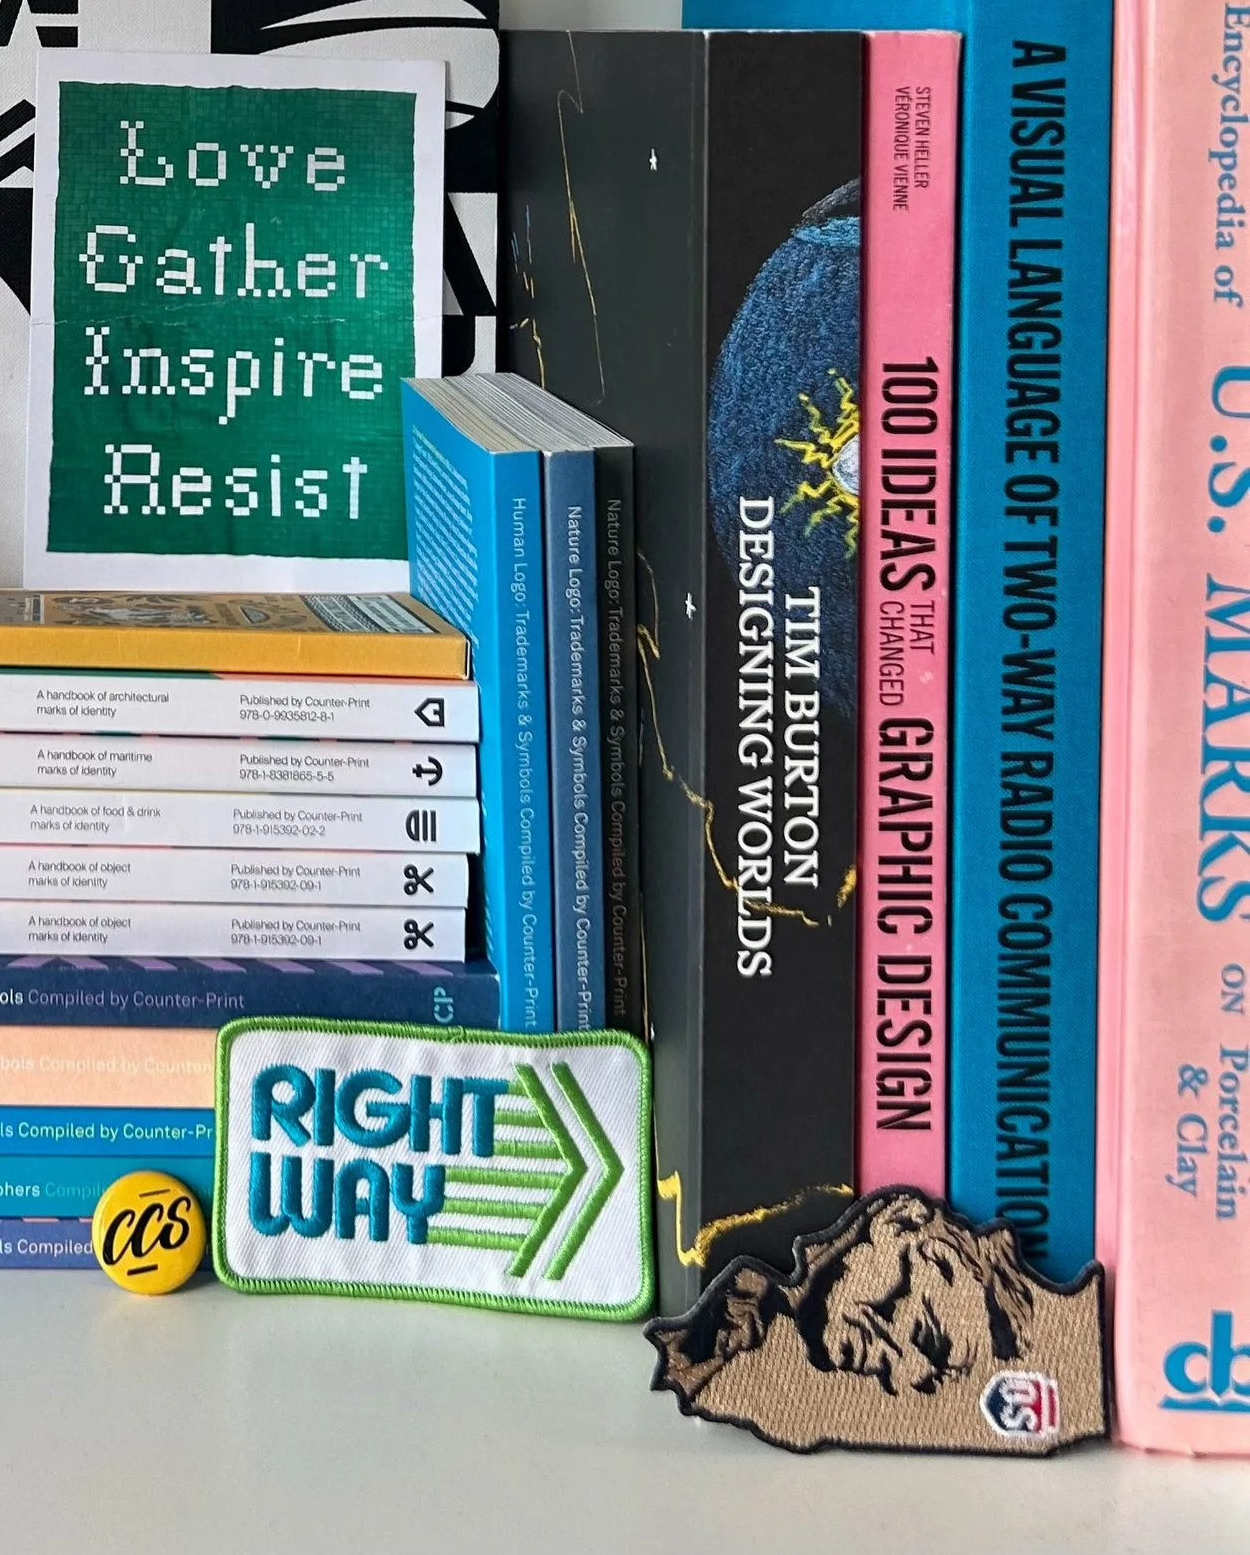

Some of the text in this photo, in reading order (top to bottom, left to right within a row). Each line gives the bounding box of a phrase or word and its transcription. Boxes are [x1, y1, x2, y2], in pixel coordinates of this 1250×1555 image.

[1011, 40, 1067, 68] A
[120, 120, 345, 191] Love
[892, 86, 913, 212] VÉRONIQUE VIENNE
[912, 86, 931, 189] STEVEN HELLER
[1009, 79, 1066, 228] VISUAL
[1207, 2, 1249, 308] Encyclopedia of
[78, 222, 389, 299] Gather
[84, 326, 383, 425] Inspire
[1005, 238, 1063, 465] LANGUAGE
[103, 443, 368, 520] Resist
[879, 356, 939, 593] 100 IDEAS
[1004, 473, 1060, 526] OF
[879, 601, 904, 707] CHANGED
[909, 603, 935, 655] THAT
[1000, 534, 1059, 742] TWO-WAY
[1196, 366, 1250, 924] U.S. MARKS
[36, 690, 169, 703] A handbook of architectural
[36, 705, 116, 718] marks of identity
[240, 695, 370, 708] Published by Counter-Print
[735, 496, 775, 978] DESIGNING WORLDS
[783, 585, 822, 889] TIM BURTON
[997, 750, 1055, 882] RADIO
[876, 717, 935, 1132] GRAPHIC DESIGN
[28, 990, 104, 1008] Compiled
[110, 990, 128, 1008] by
[133, 991, 245, 1008] Counter-Print
[251, 1063, 509, 1158] RIGHT
[1164, 1064, 1209, 1197] & Clay
[1214, 1043, 1250, 1219] Porcelain
[249, 1151, 446, 1244] WAY
